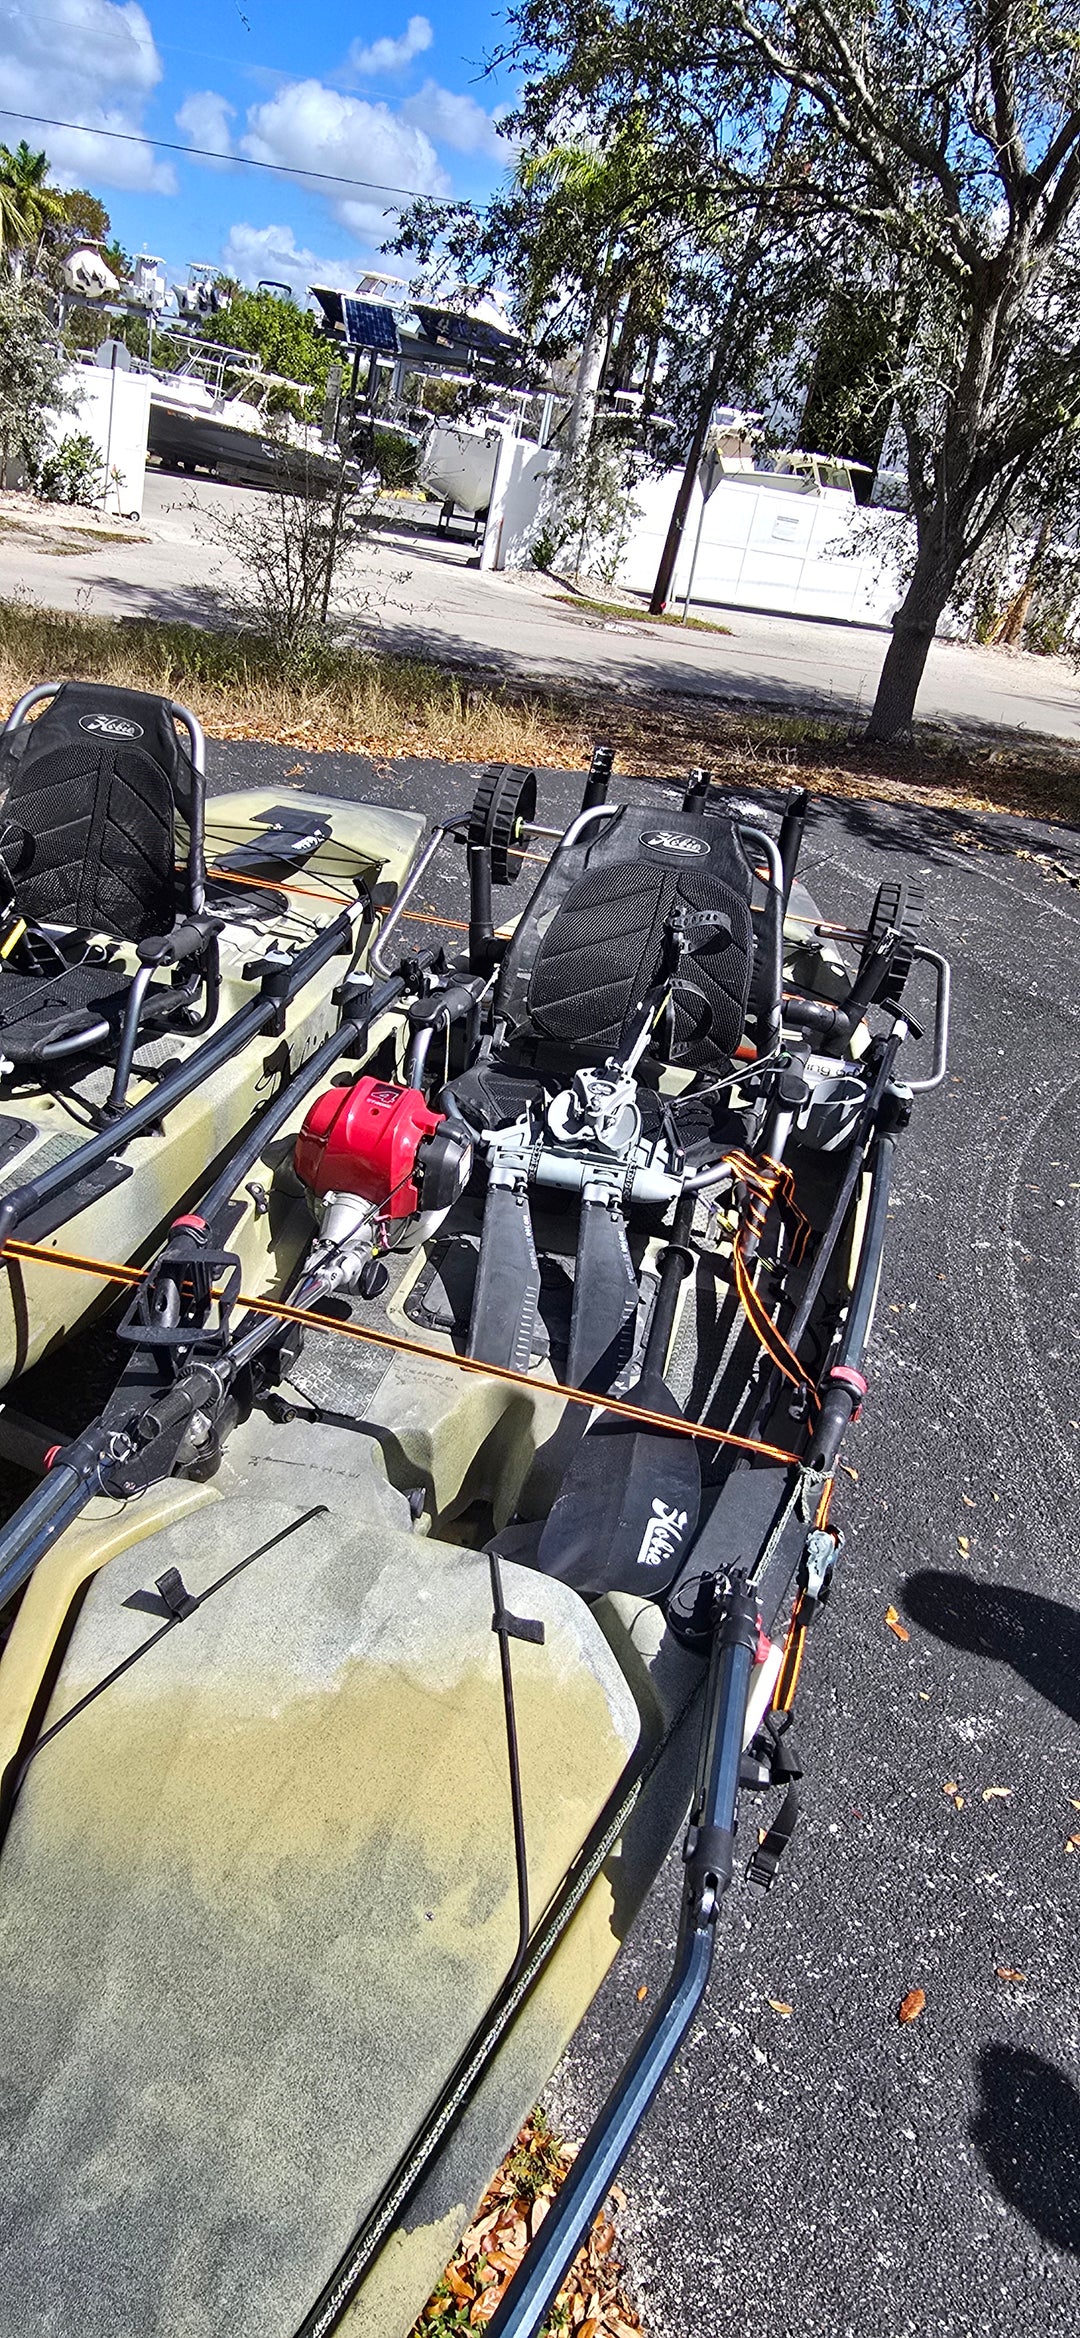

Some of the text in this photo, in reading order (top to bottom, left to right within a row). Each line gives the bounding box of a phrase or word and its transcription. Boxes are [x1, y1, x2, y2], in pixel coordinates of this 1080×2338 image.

[87, 716, 134, 737] Hobie
[648, 832, 701, 853] Hobie
[637, 1497, 688, 1566] Hobie
